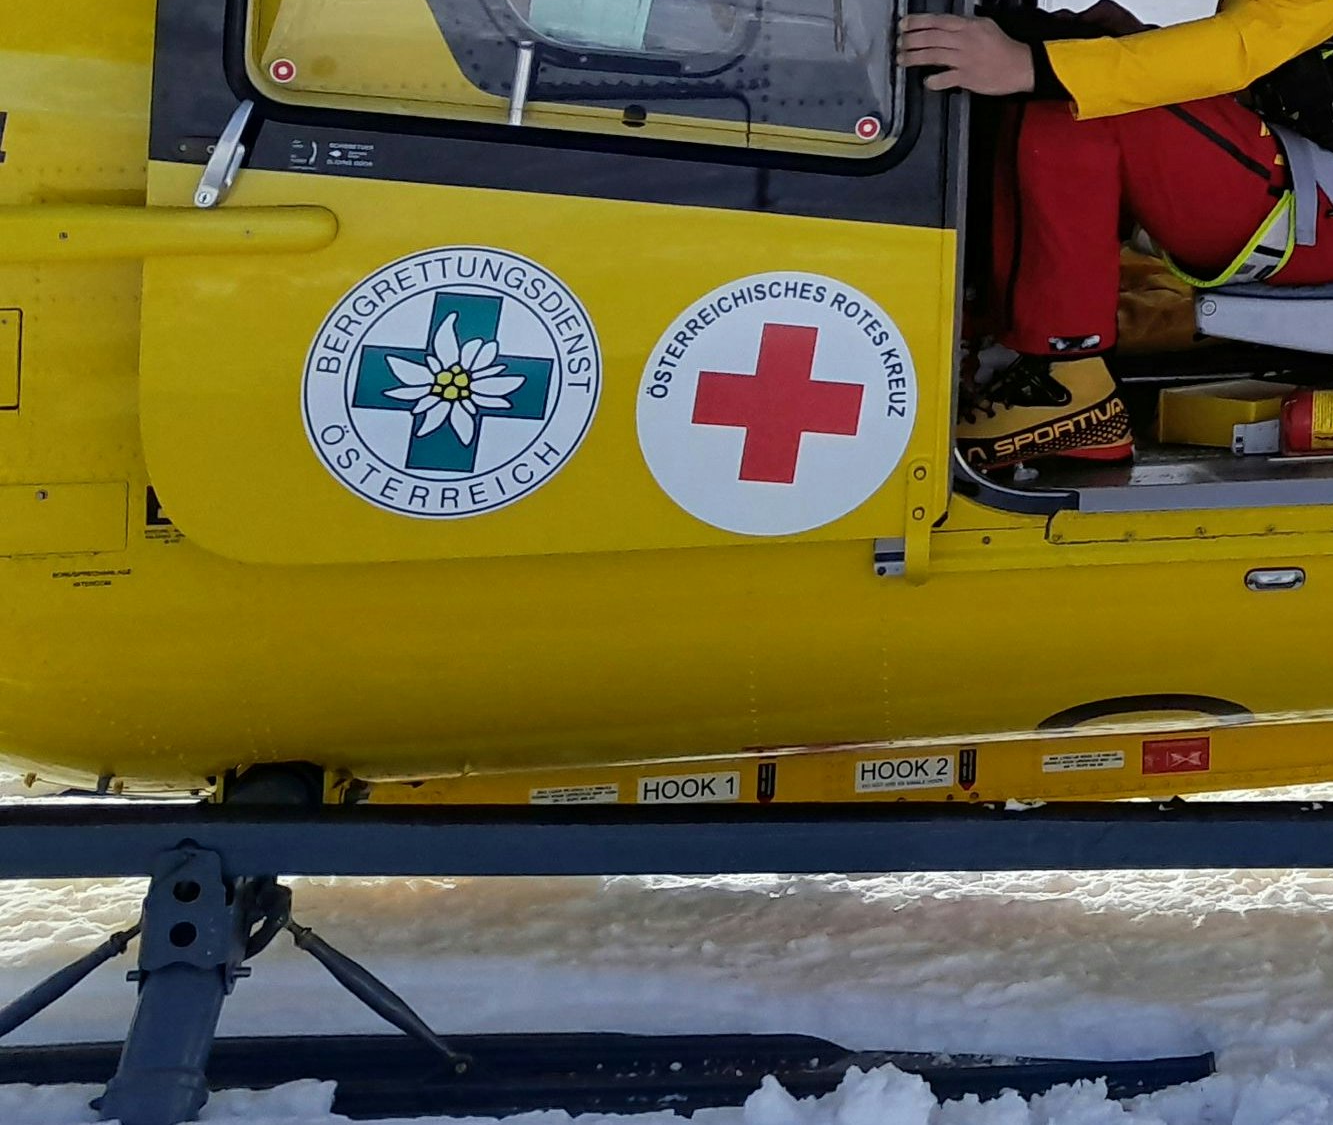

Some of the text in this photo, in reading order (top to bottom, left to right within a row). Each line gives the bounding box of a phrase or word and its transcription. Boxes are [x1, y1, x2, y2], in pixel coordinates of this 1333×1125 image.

[316, 256, 591, 394] BERGRETTUNGSDIENST
[646, 281, 906, 418] ÖSTERREICHISCHES ROTES KREUZ
[994, 397, 1124, 457] SPORTIVA
[321, 424, 560, 508] ÖSTERREICH
[643, 776, 735, 801] HOOK 1
[861, 758, 930, 781] HOOK
[936, 757, 949, 776] 2
